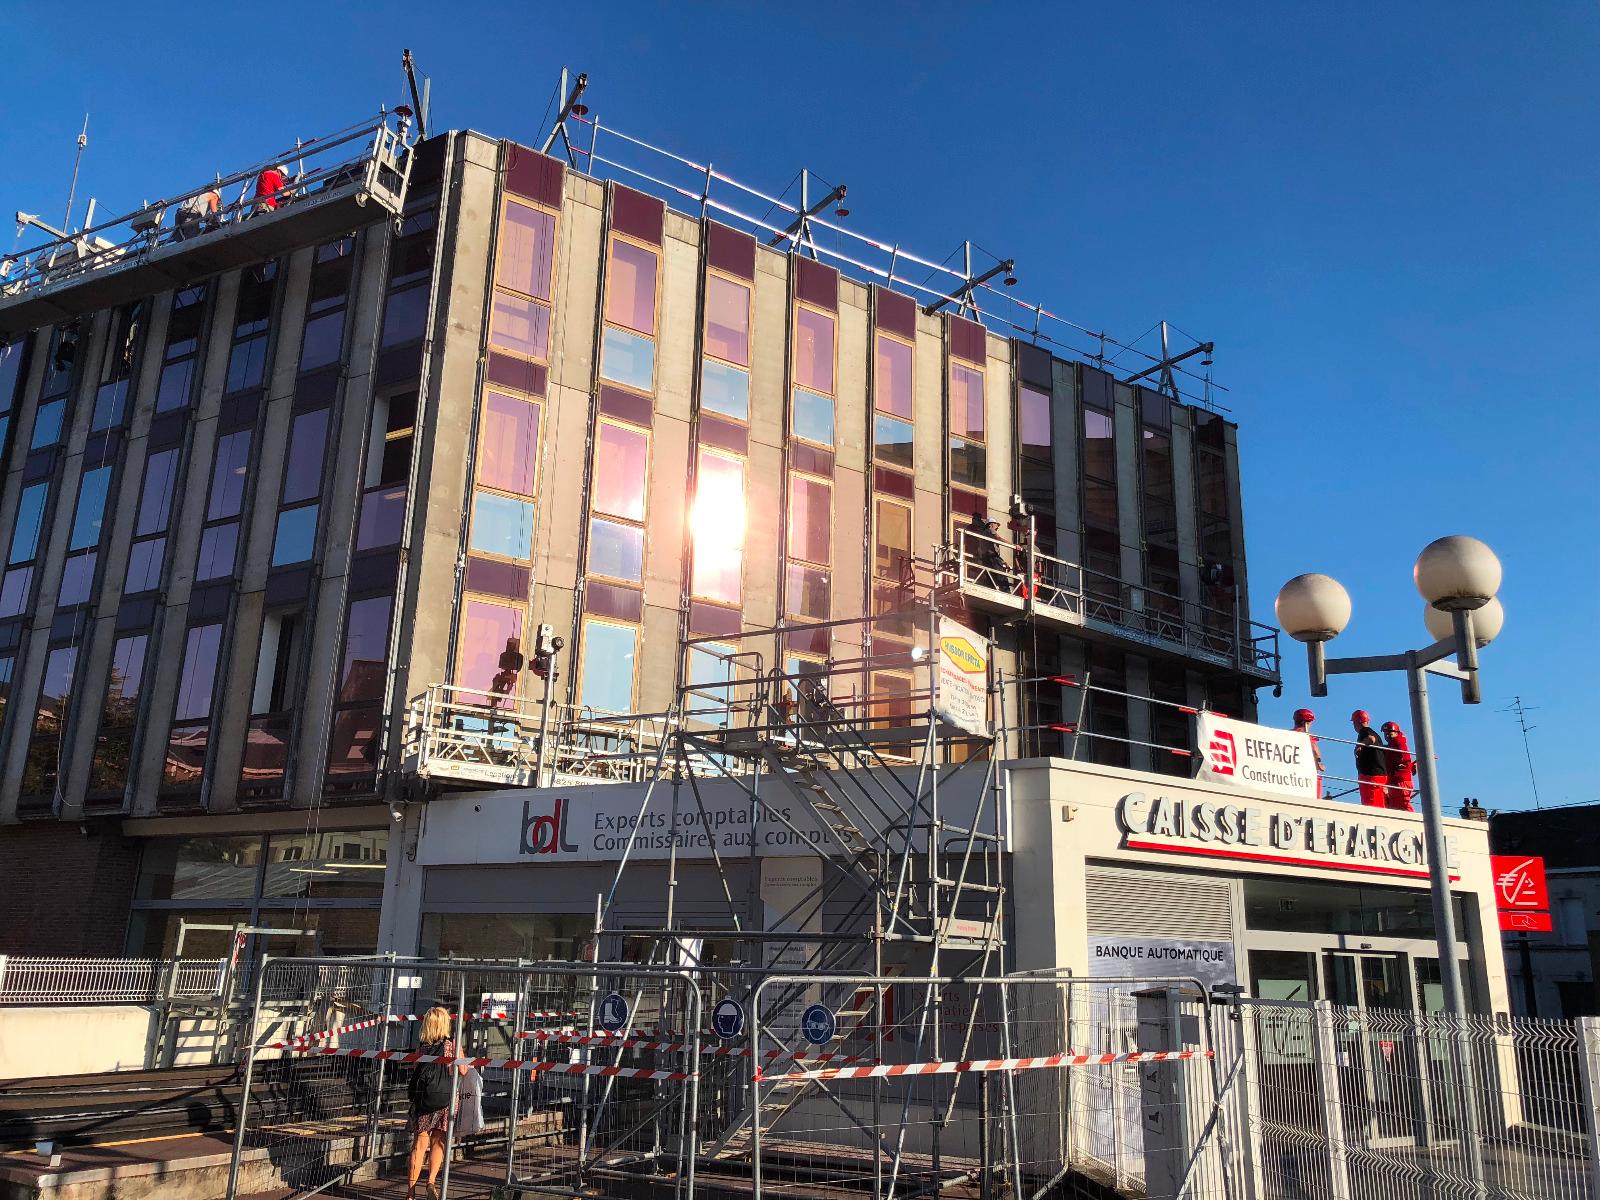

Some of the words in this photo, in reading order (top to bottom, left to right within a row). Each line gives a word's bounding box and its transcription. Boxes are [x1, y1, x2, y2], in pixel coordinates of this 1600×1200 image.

[1245, 738, 1301, 764] EIFFAGE
[1242, 765, 1313, 788] Construction
[519, 799, 579, 854] bdl
[594, 812, 665, 833] Experts
[672, 806, 791, 830] comptables
[1120, 791, 1263, 847] CAISSE
[723, 833, 758, 847] aux
[765, 829, 852, 849] compts
[1095, 945, 1143, 960] BANQUE
[1147, 947, 1224, 962] AUTOMATIQUE
